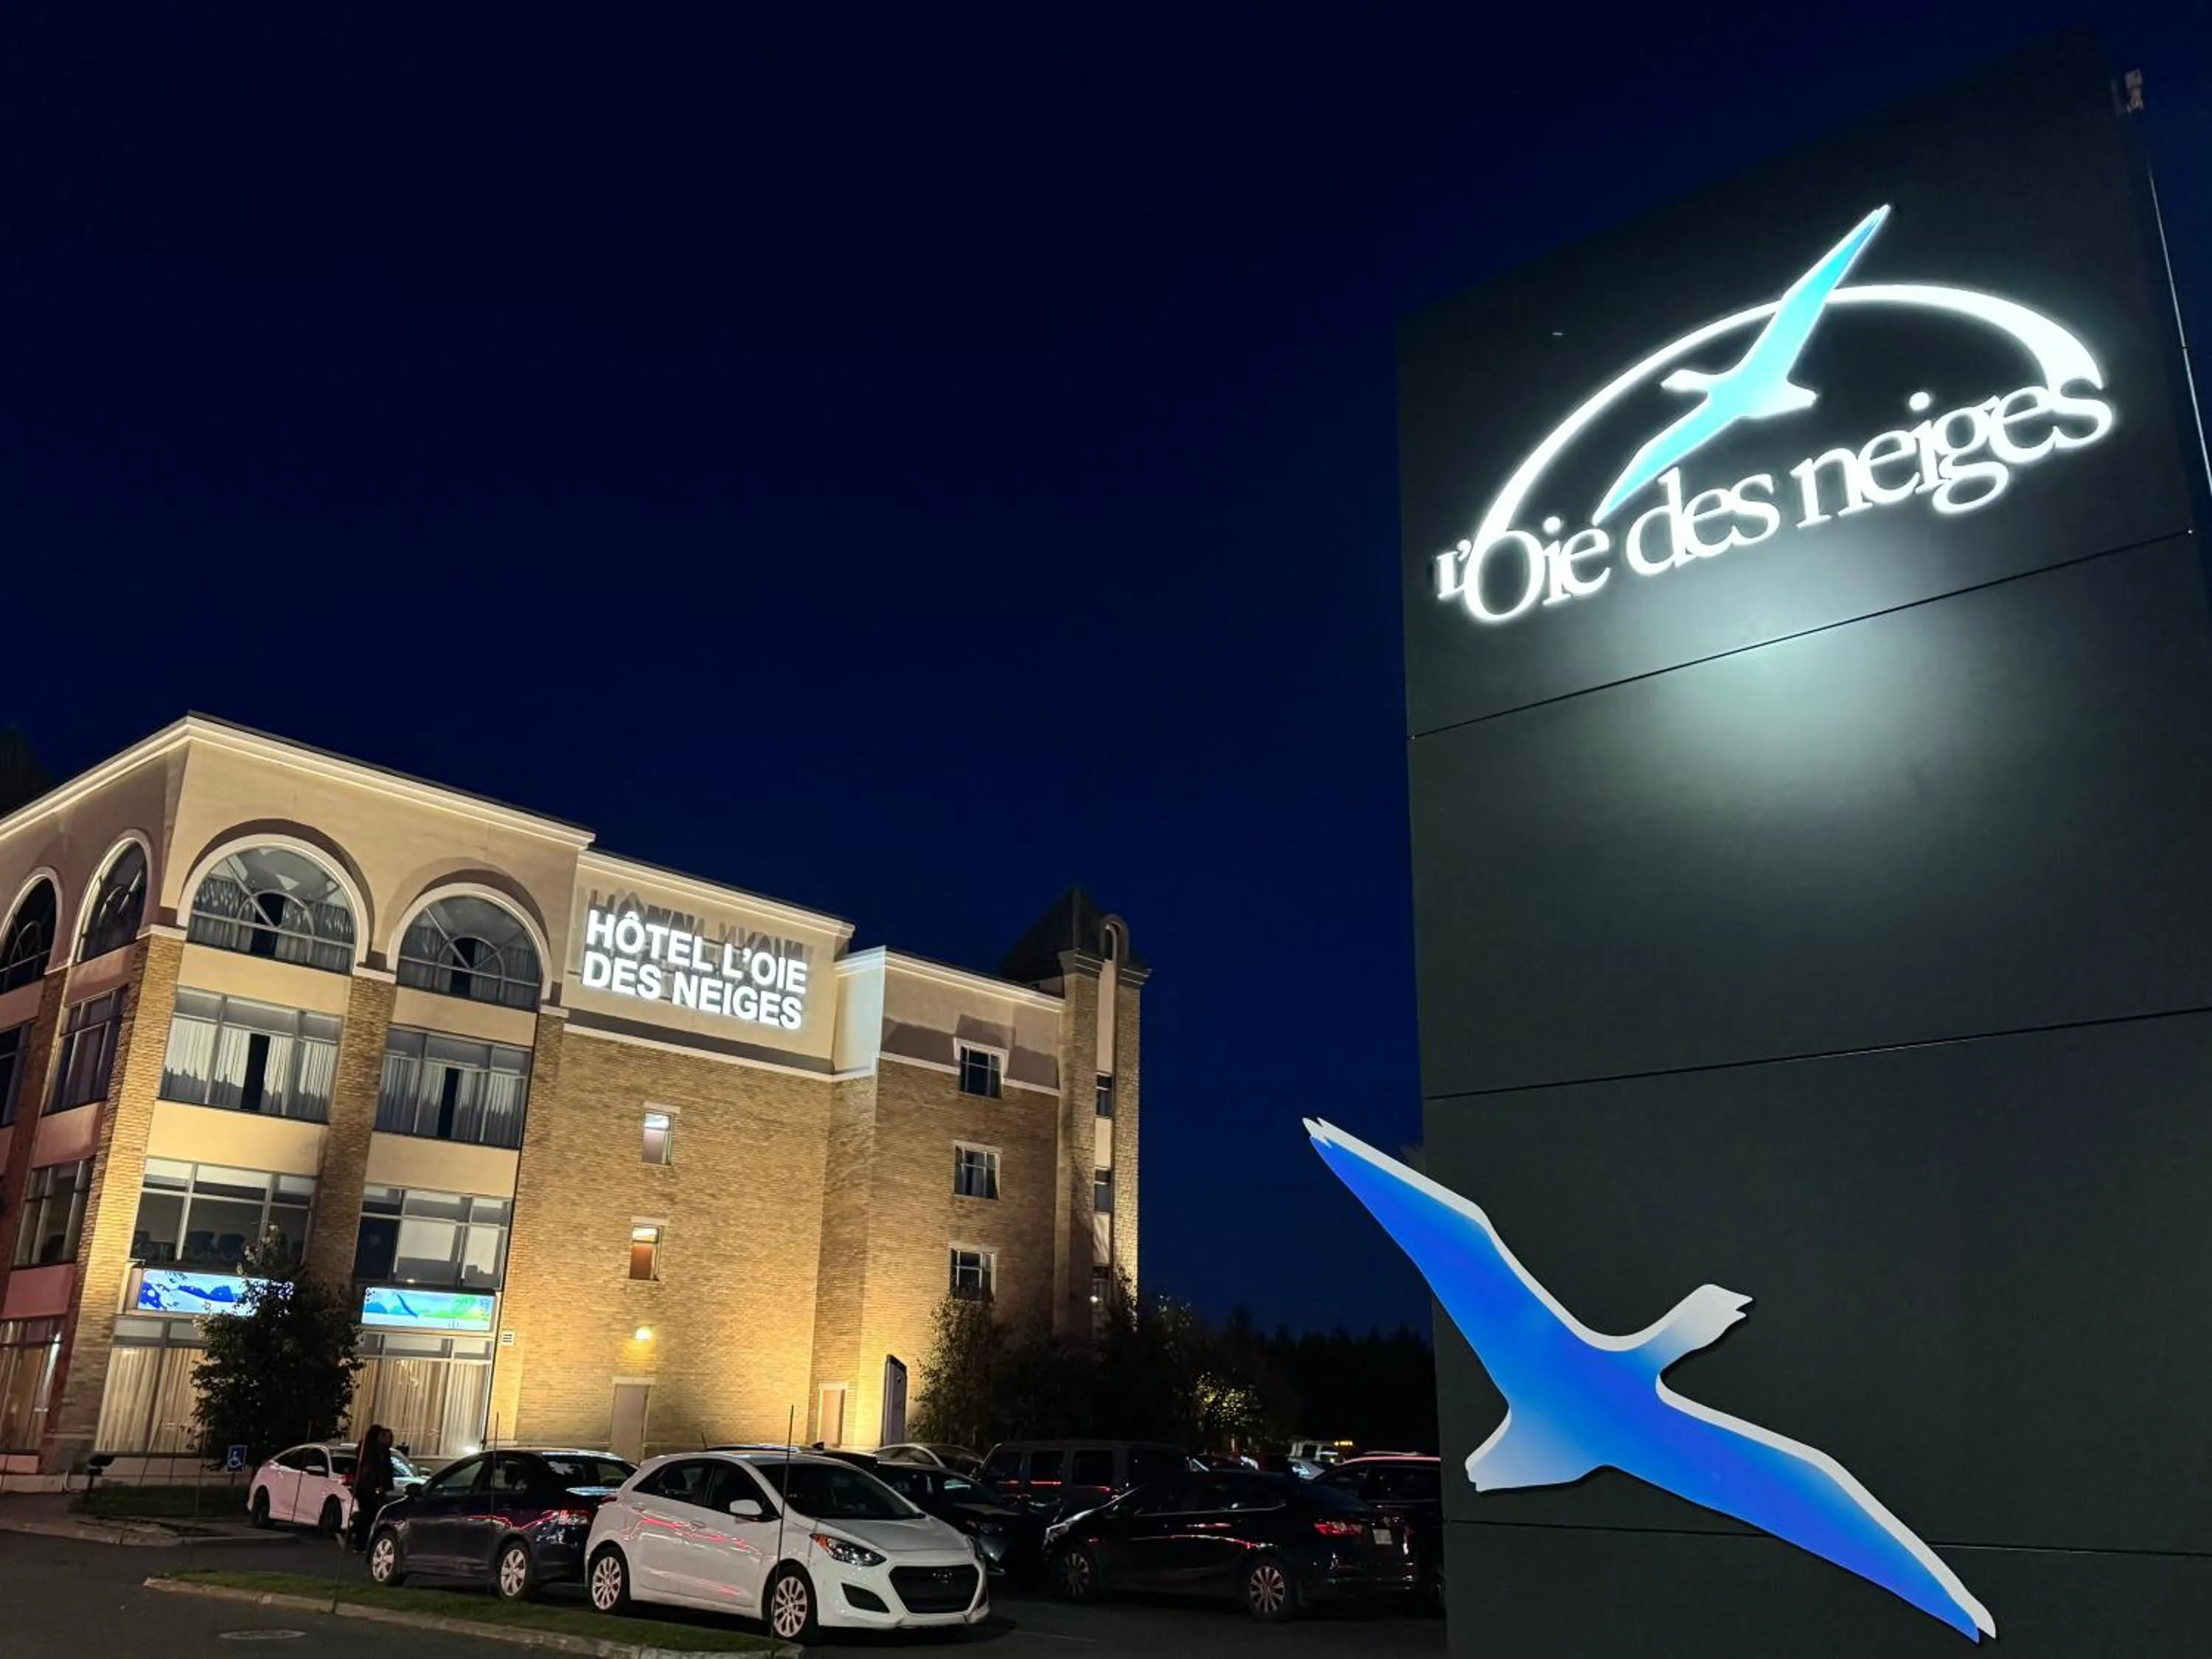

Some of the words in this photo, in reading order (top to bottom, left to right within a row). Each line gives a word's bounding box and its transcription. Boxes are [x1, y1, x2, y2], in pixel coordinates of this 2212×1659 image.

[1626, 467, 1781, 577] des
[1790, 375, 2113, 528] neiges
[582, 950, 662, 1000] DES
[672, 970, 804, 1030] NEIGES
[586, 909, 713, 973] HÔTEL
[722, 942, 808, 995] L'OIE
